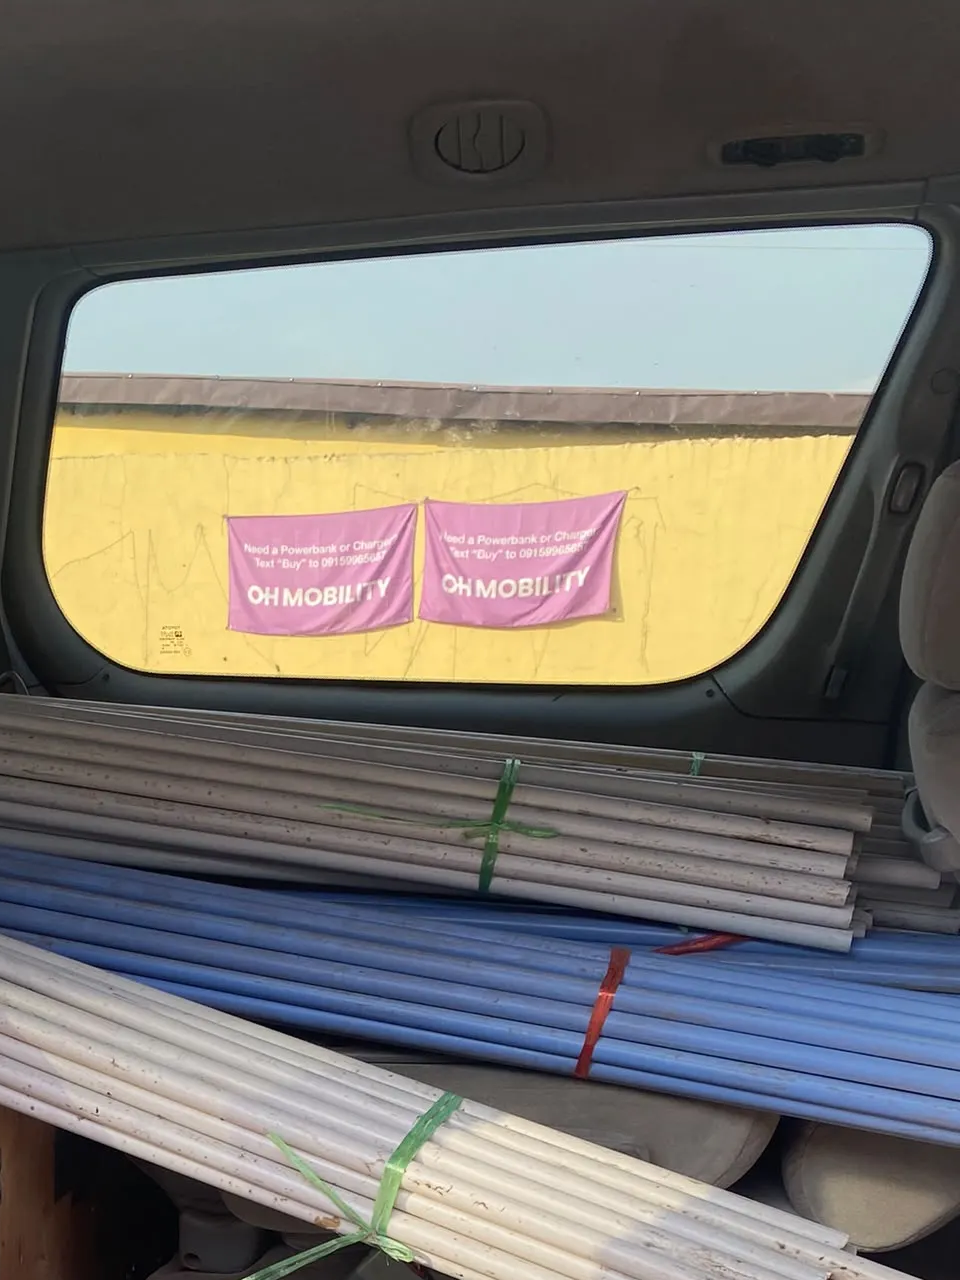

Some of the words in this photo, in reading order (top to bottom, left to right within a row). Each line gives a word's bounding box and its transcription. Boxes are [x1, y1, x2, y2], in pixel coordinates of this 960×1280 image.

[477, 534, 537, 546] Powerbank
[281, 543, 337, 555] Powerbank
[506, 550, 517, 559] to
[309, 559, 319, 568] to
[442, 573, 471, 597] OH
[476, 566, 590, 599] MOBILITY
[248, 585, 279, 606] OH
[283, 576, 390, 607] MOBILITY
